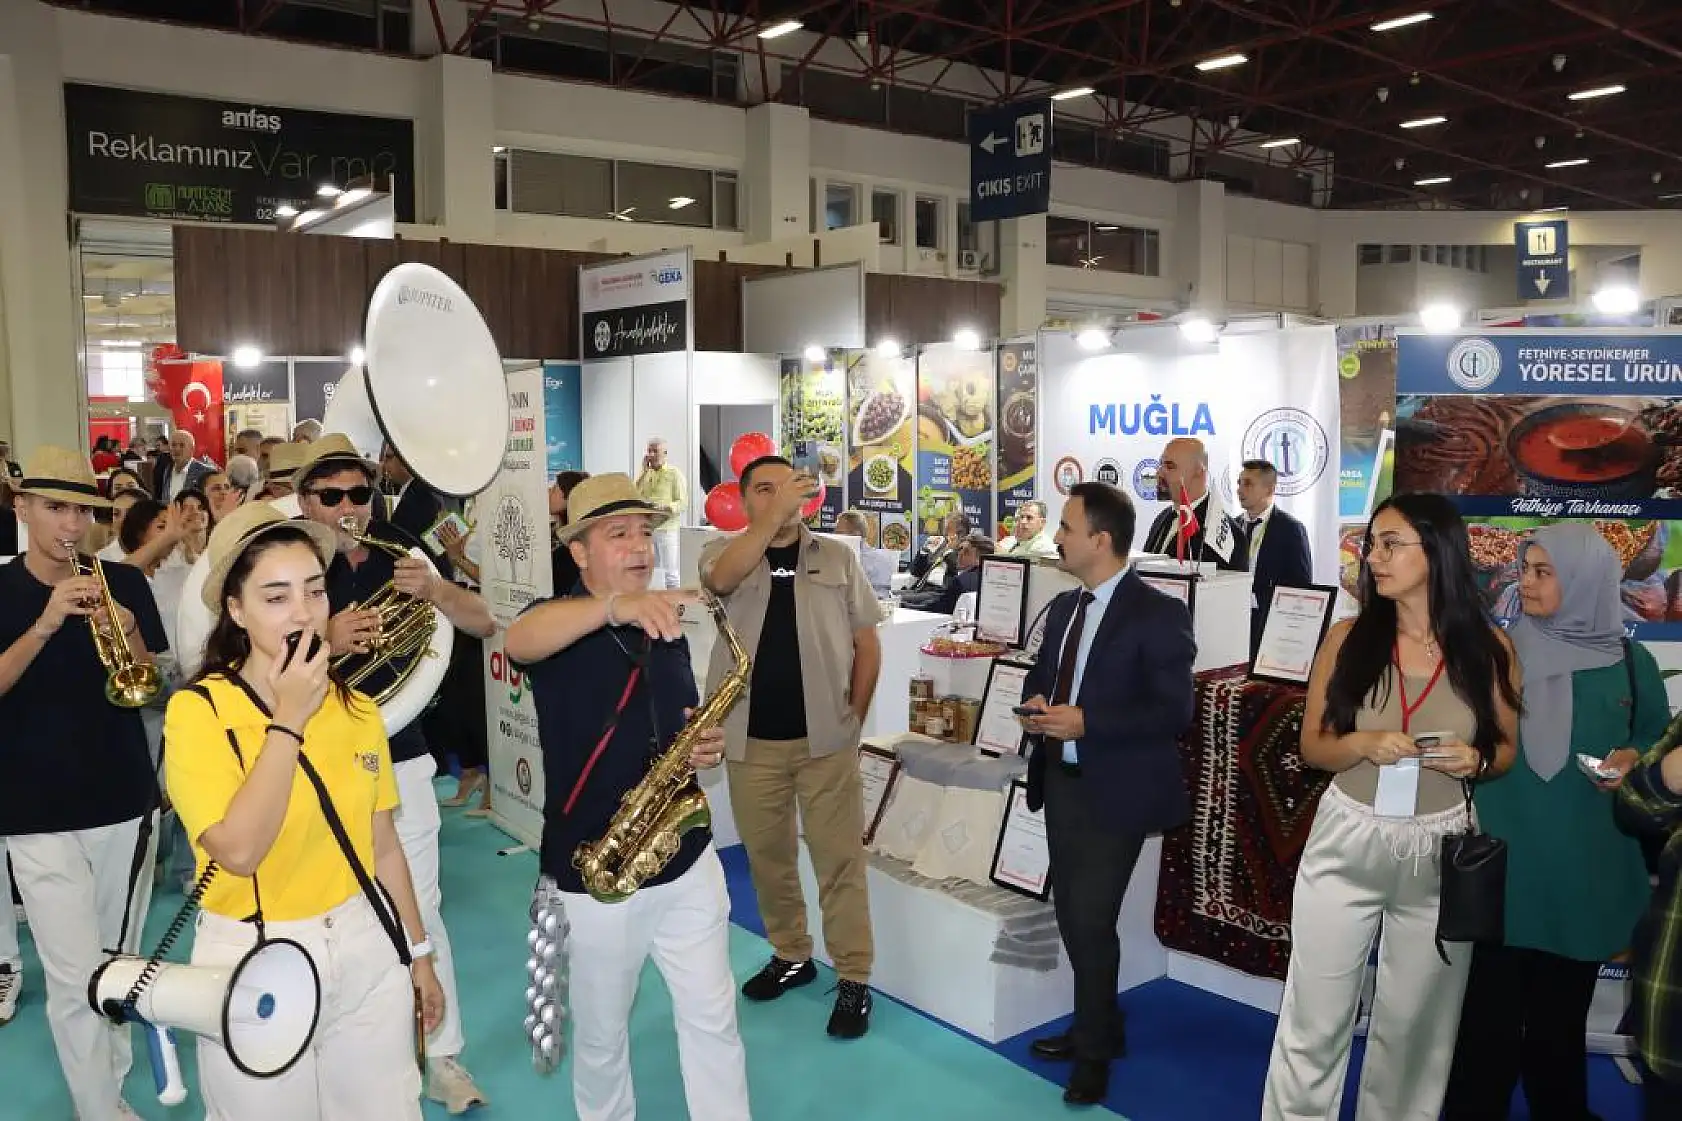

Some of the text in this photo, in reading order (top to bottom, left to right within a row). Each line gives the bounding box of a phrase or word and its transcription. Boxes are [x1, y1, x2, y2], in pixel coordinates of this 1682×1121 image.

[222, 109, 282, 133] anfaş
[89, 131, 254, 169] Reklamınız
[254, 142, 316, 181] Var
[977, 172, 1043, 198] ÇIKIŞ EXIT
[1518, 346, 1649, 361] FETHİYE-SEYDİKEMER
[1518, 359, 1682, 383] YÖRESEL ÜRÜN
[1089, 393, 1216, 436] MUĞLA
[1510, 497, 1642, 517] Fethiye Tarhanası
